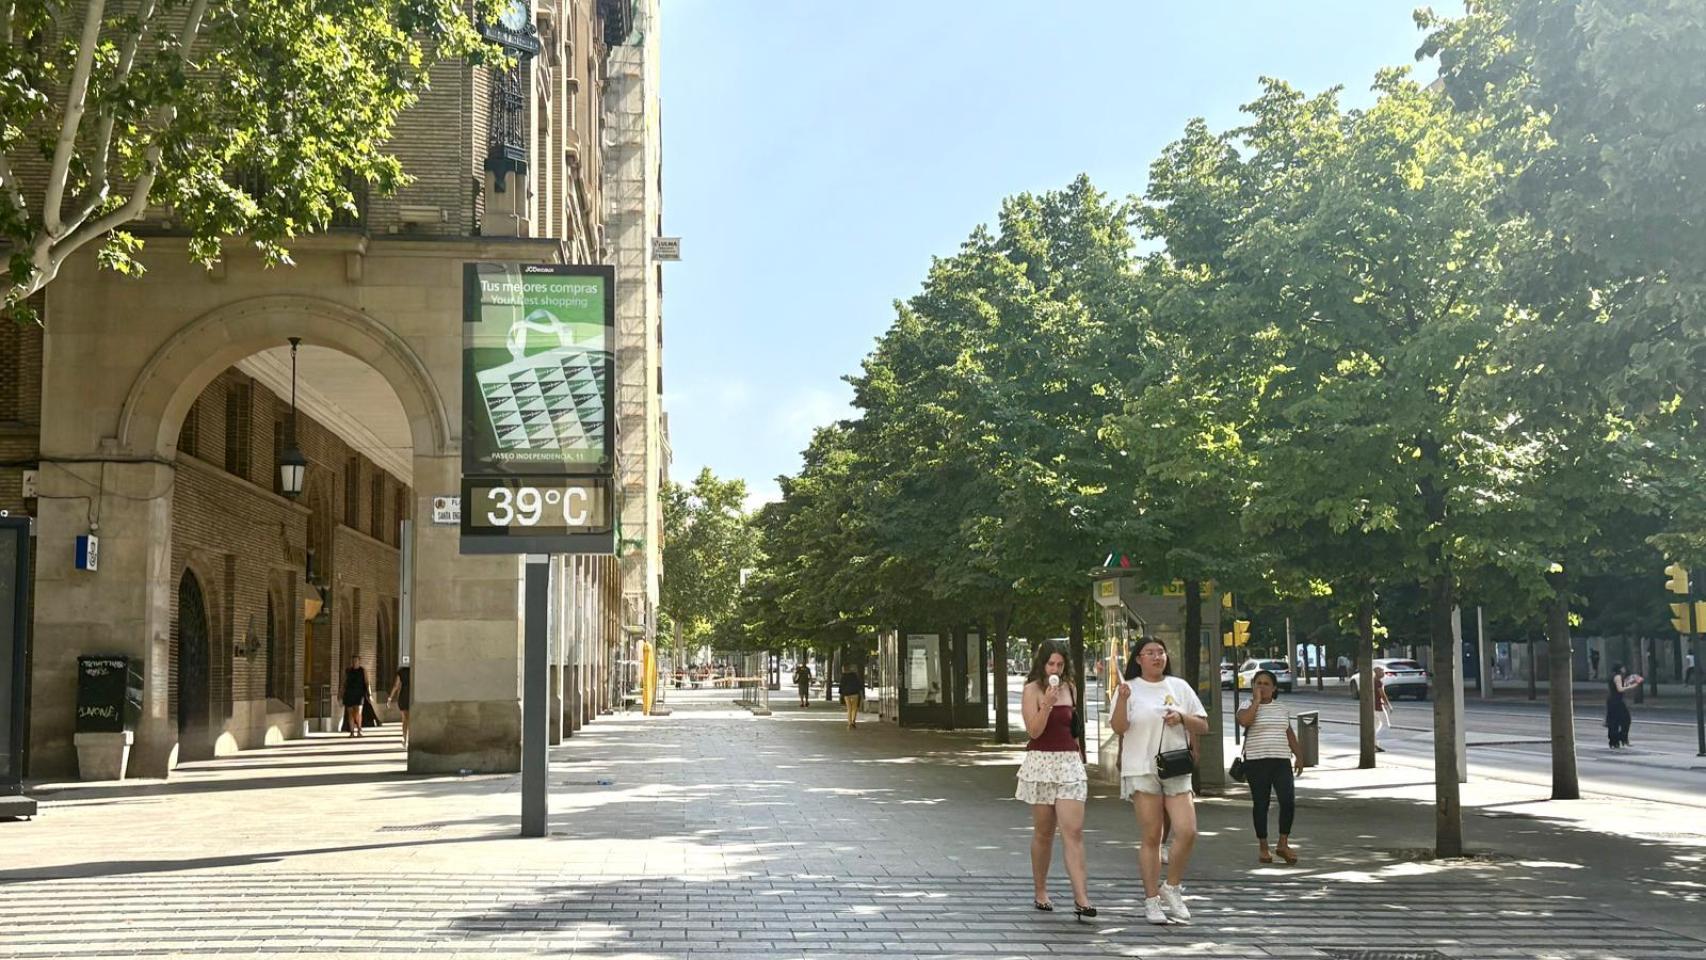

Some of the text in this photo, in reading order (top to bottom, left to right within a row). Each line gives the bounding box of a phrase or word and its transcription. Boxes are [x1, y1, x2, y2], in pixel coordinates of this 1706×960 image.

[481, 281, 597, 294] Tus mejores compras
[540, 296, 588, 307] shopping
[487, 487, 587, 526] 39°C
